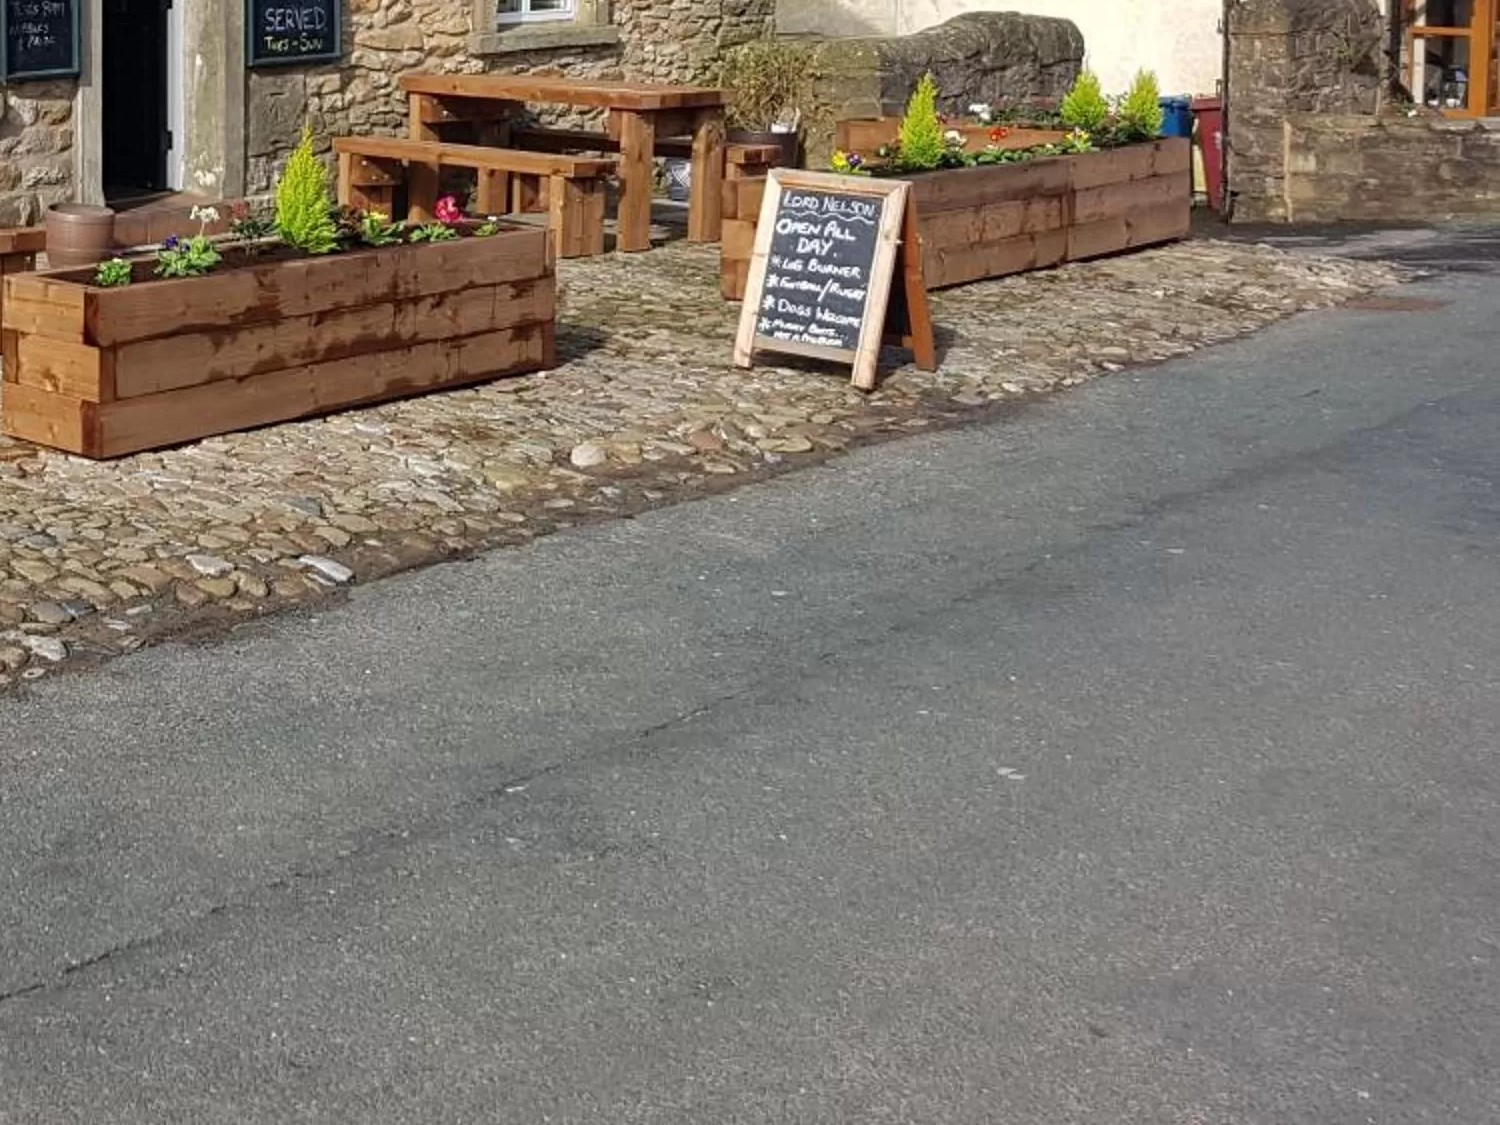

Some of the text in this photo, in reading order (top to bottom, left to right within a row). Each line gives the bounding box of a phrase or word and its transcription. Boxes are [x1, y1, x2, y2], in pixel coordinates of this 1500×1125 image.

[265, 7, 327, 31] SERVED
[783, 191, 876, 216] LORD NELSON
[776, 218, 856, 242] OPEN ALL
